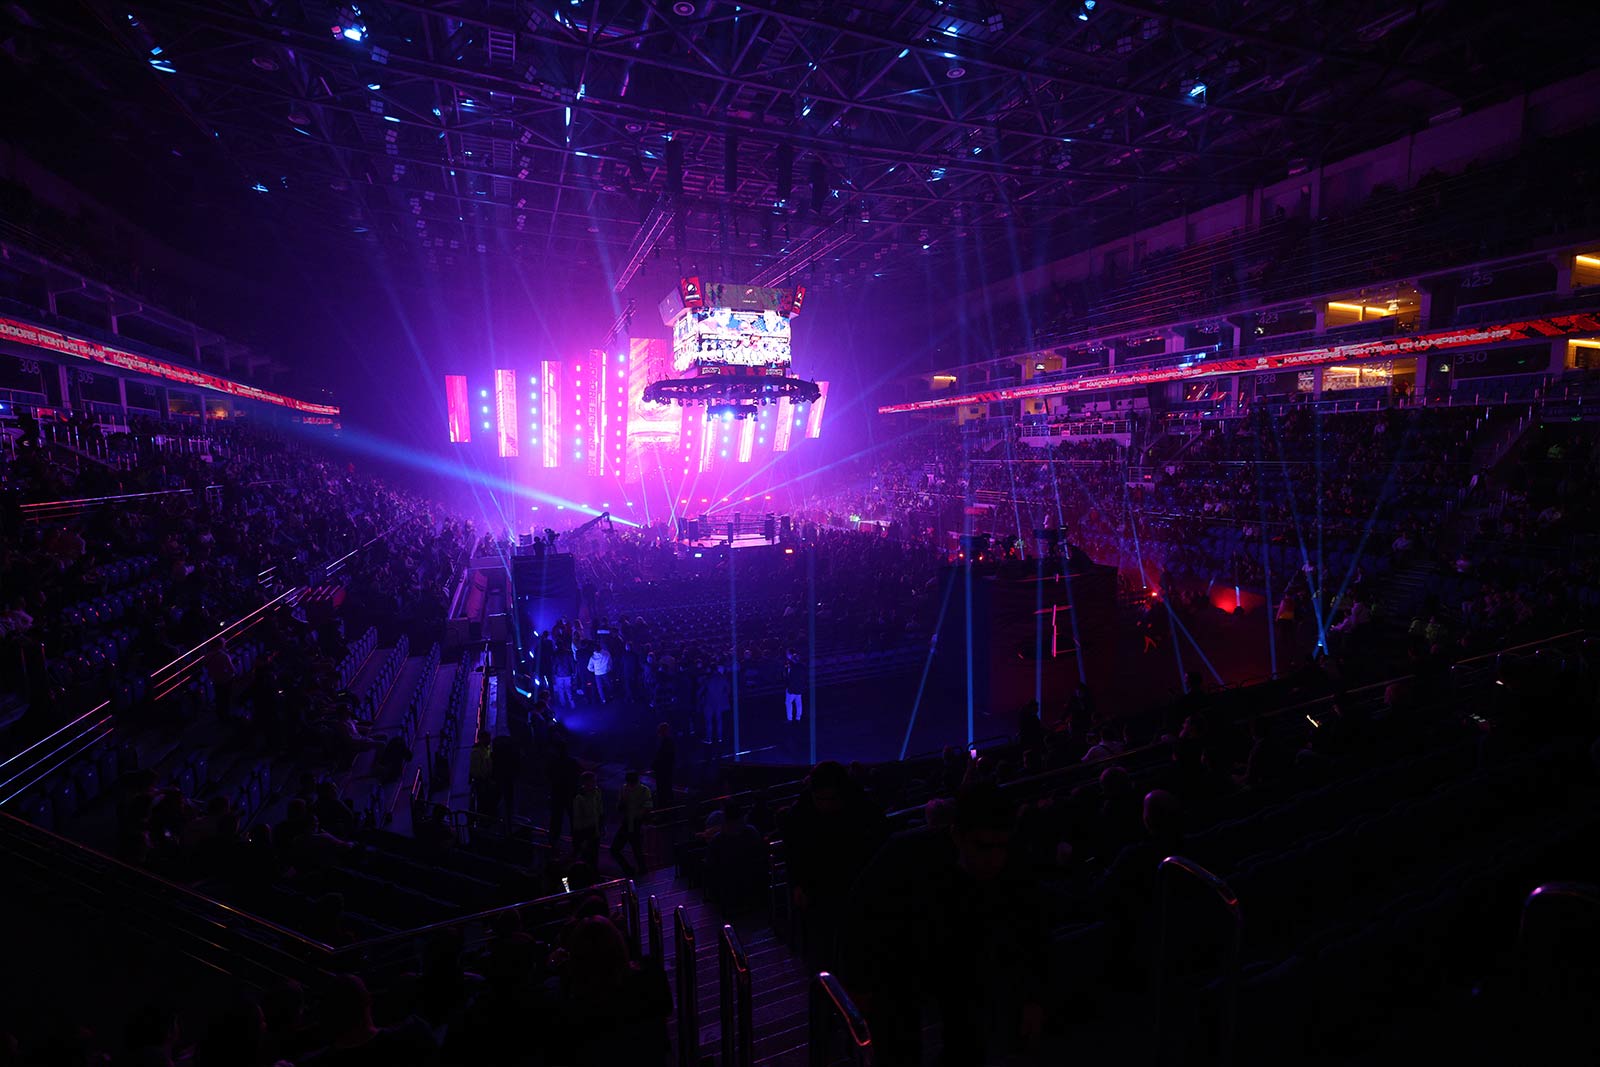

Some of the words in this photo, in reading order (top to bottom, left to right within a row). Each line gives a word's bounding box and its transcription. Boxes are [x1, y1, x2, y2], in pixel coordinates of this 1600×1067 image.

[1461, 273, 1494, 288] 425
[1258, 312, 1279, 324] 423
[1283, 351, 1341, 364] HARDCORE
[1342, 343, 1398, 357] FIGHTING
[1399, 329, 1512, 350] CHAMPIONSHIP
[1456, 351, 1488, 365] 330
[19, 359, 41, 375] 308
[1148, 368, 1202, 380] CHAMPIONSHIP
[1256, 373, 1277, 385] 328
